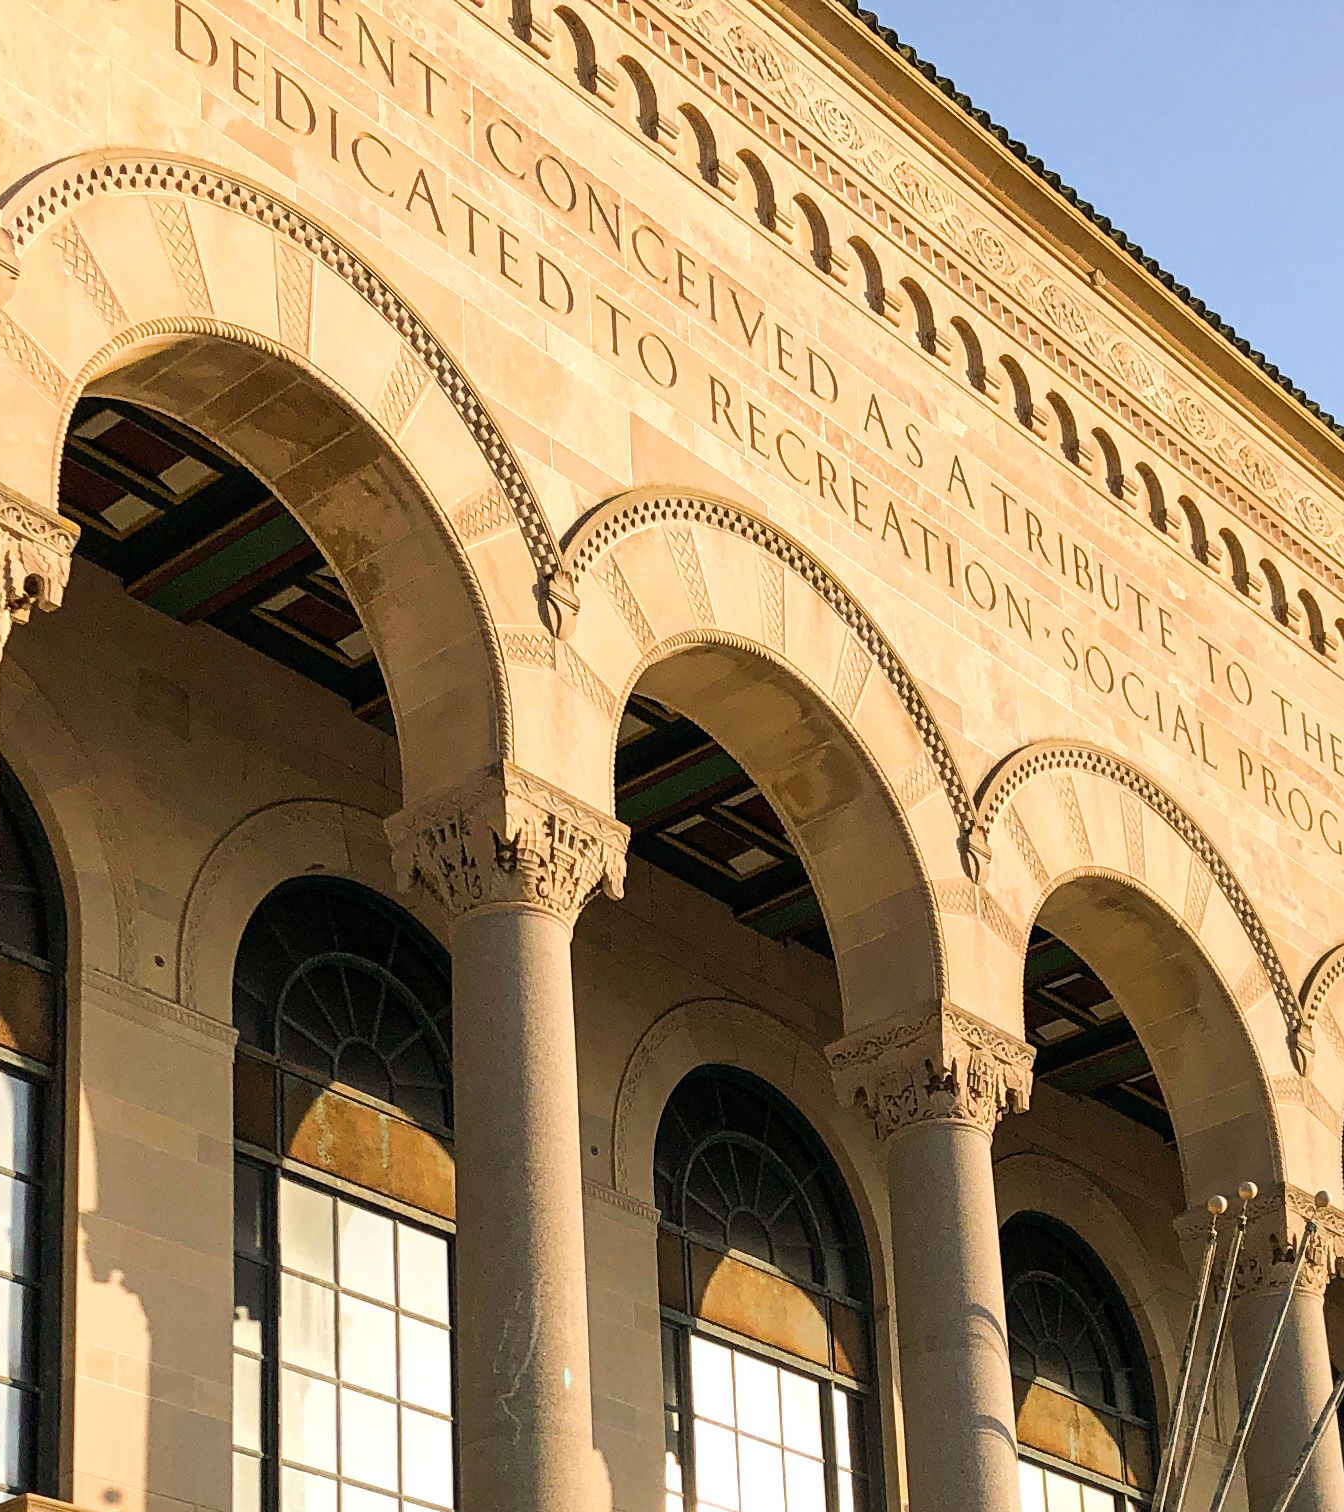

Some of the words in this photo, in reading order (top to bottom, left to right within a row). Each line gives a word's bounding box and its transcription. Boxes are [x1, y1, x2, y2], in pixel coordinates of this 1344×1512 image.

[174, 0, 574, 314] DEDICATED
[596, 294, 677, 388] TO
[1061, 627, 1218, 770] SOCIAL
[485, 117, 839, 404] CONCEIVED
[864, 393, 924, 468] AS
[946, 454, 975, 509] A
[991, 482, 1176, 655] TRIBUTE
[1198, 636, 1252, 705] TO
